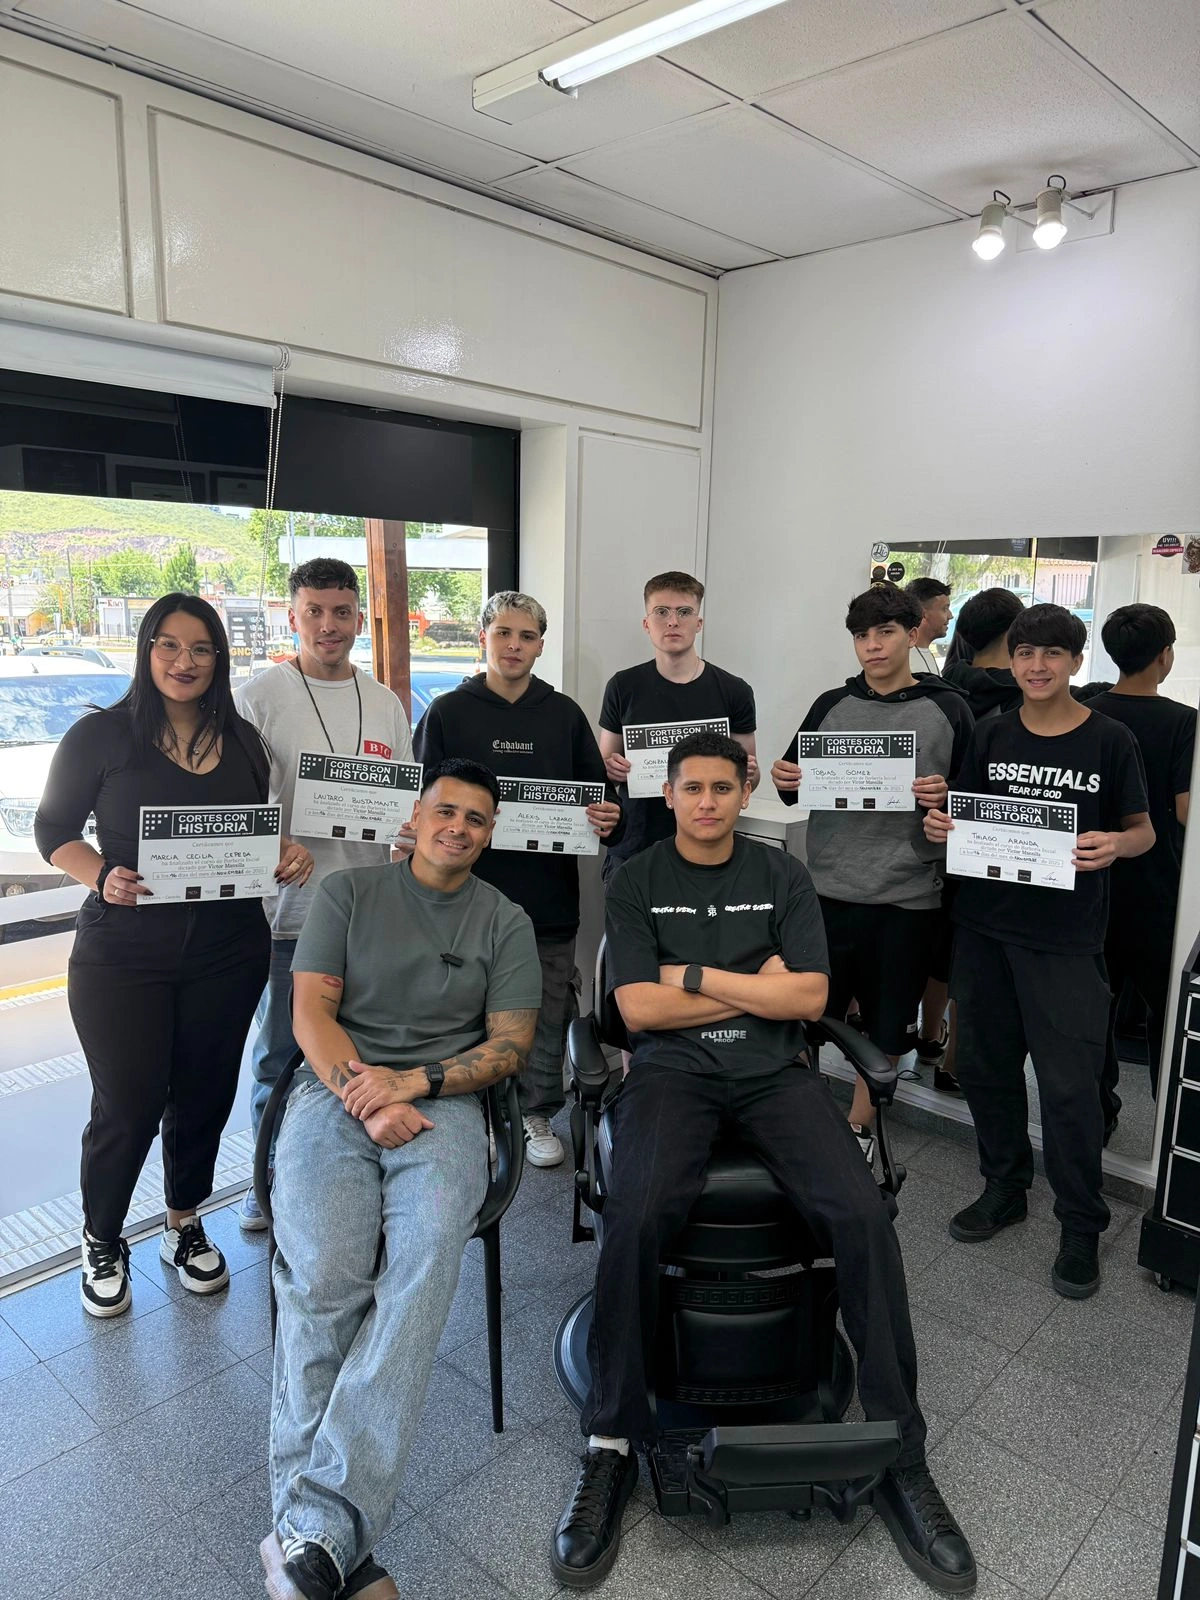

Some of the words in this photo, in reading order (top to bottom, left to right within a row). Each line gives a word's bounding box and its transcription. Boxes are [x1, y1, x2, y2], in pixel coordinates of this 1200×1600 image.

[650, 728, 682, 737] CORTES
[492, 739, 534, 751] Endavant
[827, 745, 885, 754] HISTORIA
[330, 760, 369, 772] CORTES
[369, 765, 391, 774] CON
[329, 768, 392, 784] HISTORIA
[988, 763, 1101, 793] ESSENTIALS
[523, 785, 557, 793] CORTES
[1008, 785, 1031, 796] FEAR
[1031, 788, 1043, 797] OF
[1043, 790, 1062, 800] GOD
[523, 791, 577, 802] HISTORIA
[351, 797, 399, 808] BUSTAMANTE
[980, 801, 1018, 813] CORTES
[1020, 806, 1042, 815] CON
[178, 814, 222, 823] CORTES
[224, 813, 247, 822] CON
[980, 809, 1043, 825] HISTORIA
[178, 821, 249, 834] HISTORIA
[1008, 838, 1039, 848] ARANDA
[701, 1029, 747, 1040] FUTURE
